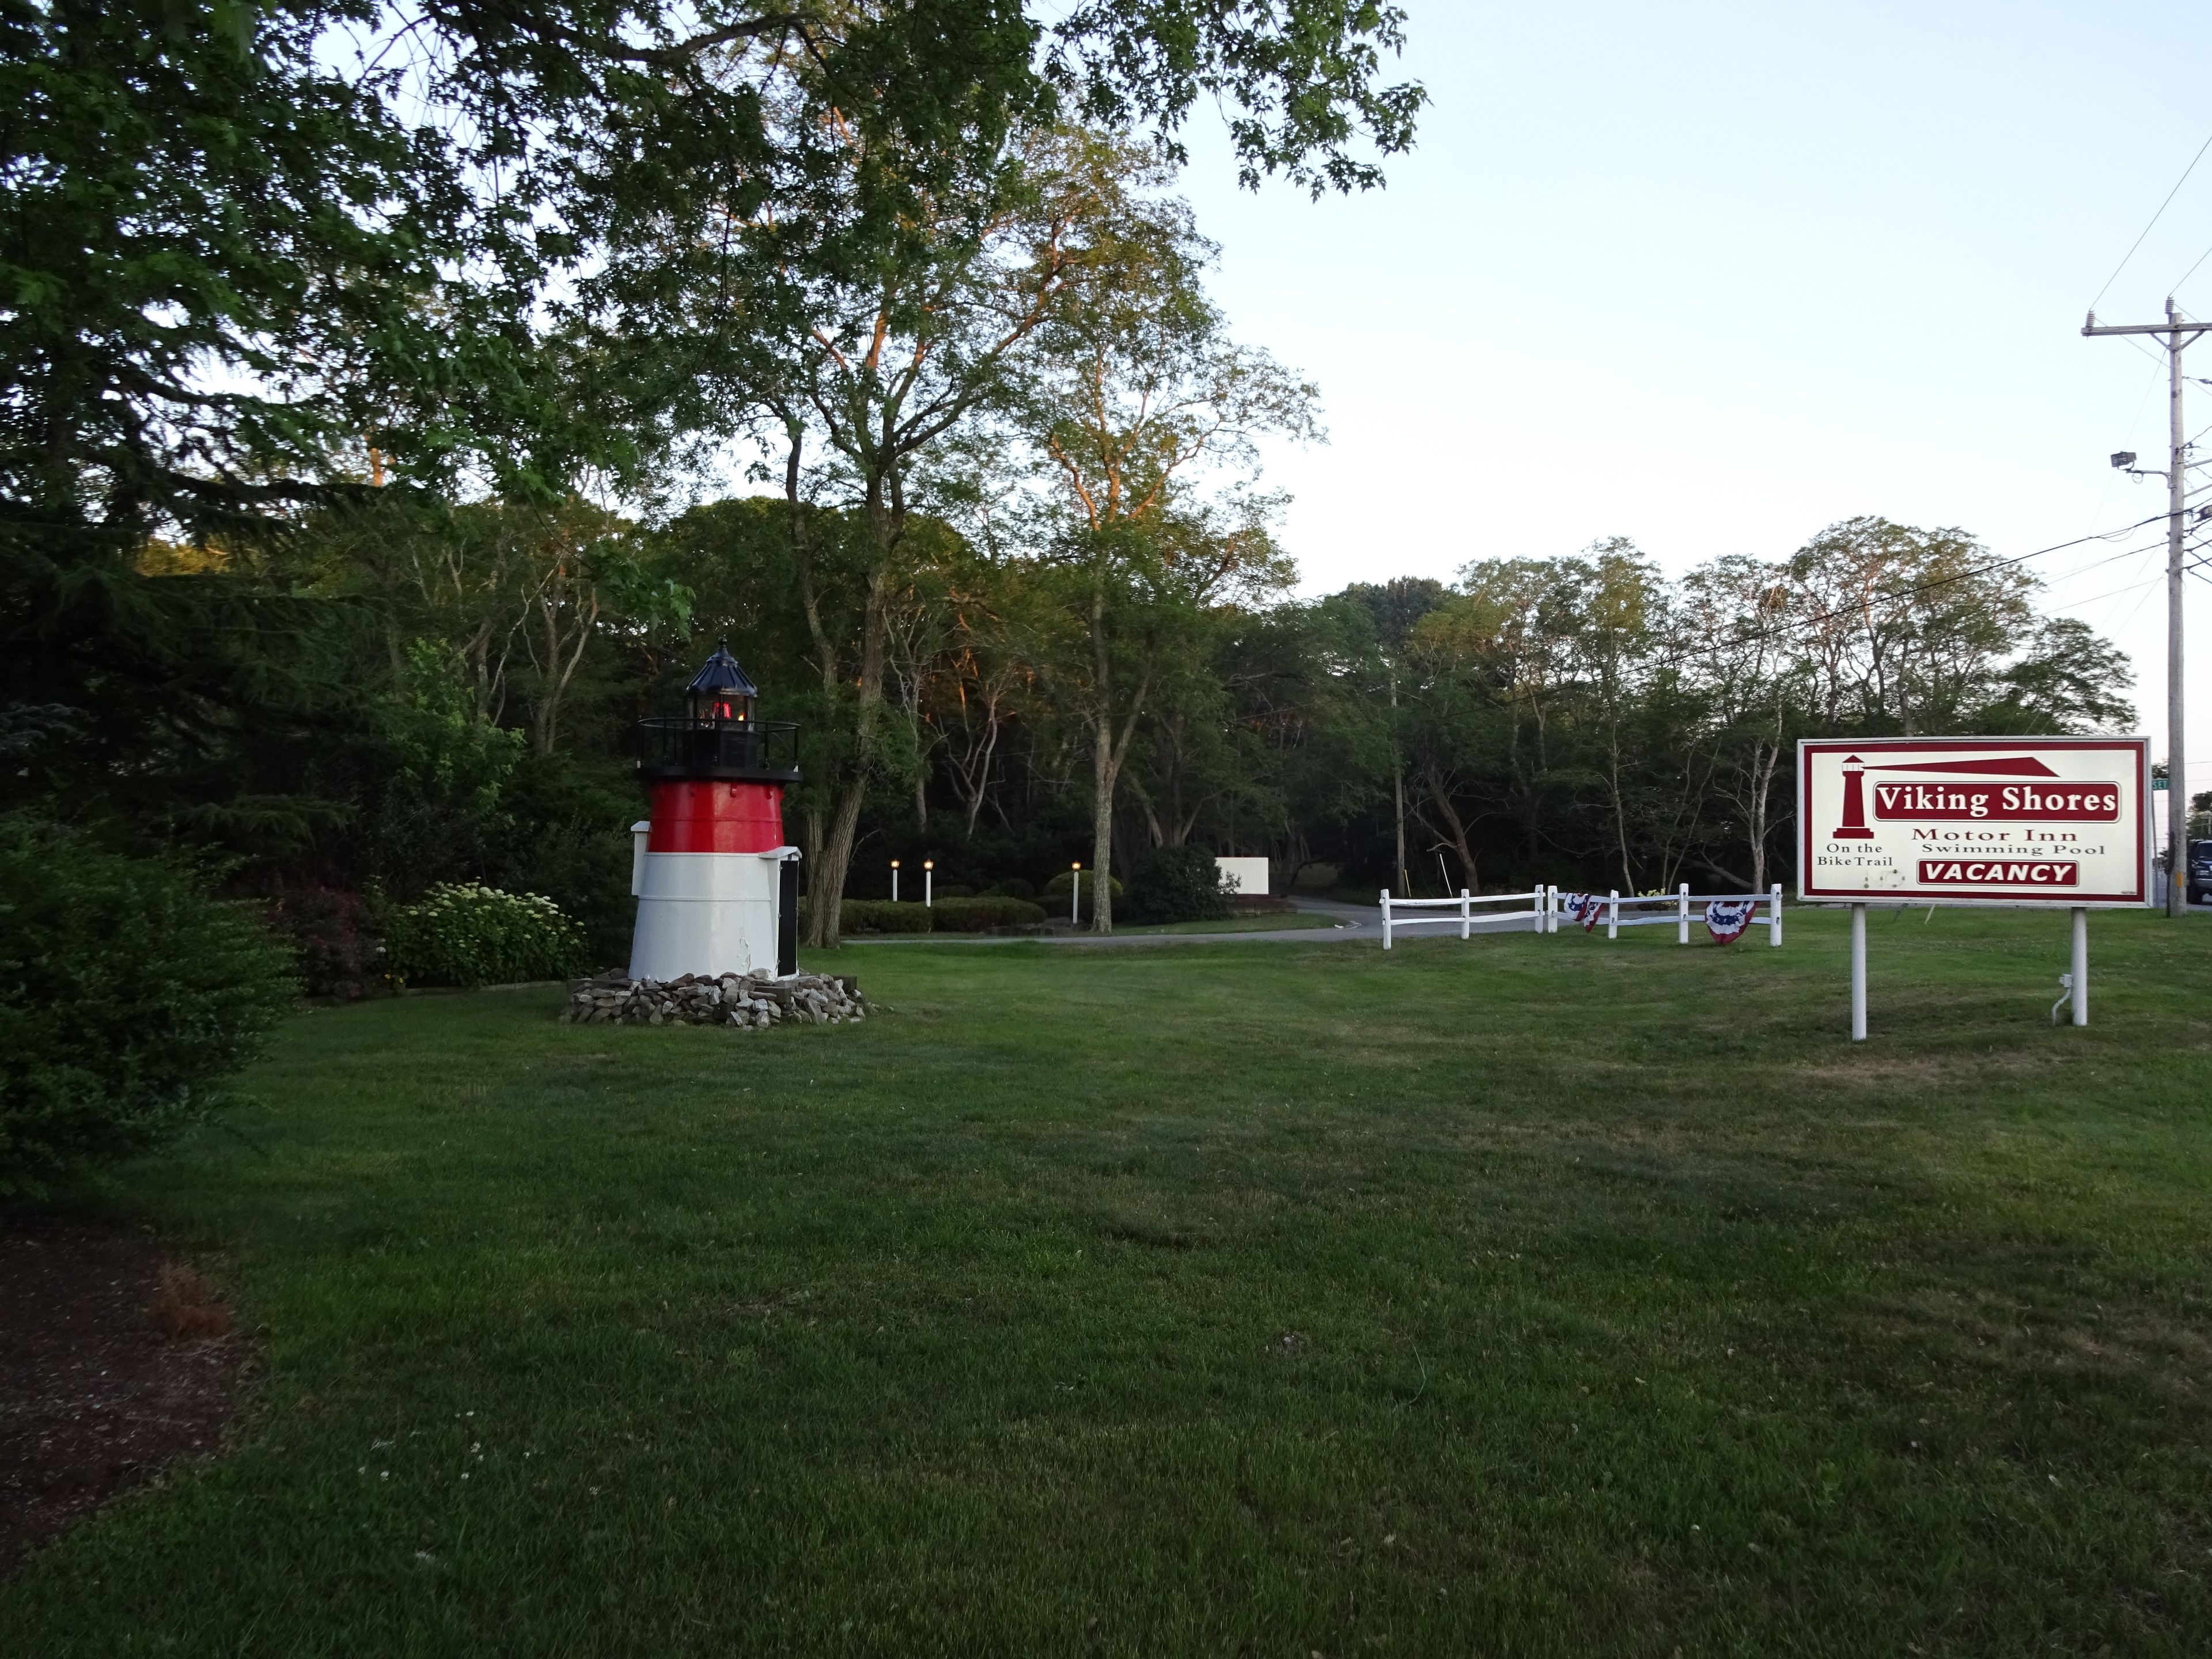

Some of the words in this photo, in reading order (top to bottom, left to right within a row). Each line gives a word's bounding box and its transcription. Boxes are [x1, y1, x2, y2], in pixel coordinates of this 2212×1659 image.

[1877, 786, 1989, 817] Viking
[2002, 786, 2116, 811] Shores
[1911, 828, 2010, 841] Motor
[2024, 829, 2078, 842] Inn
[1827, 843, 1851, 853] On
[1858, 843, 1883, 853] the
[1922, 844, 2043, 856] Swimming
[2053, 845, 2105, 854] Pool
[1817, 856, 1852, 865] Bike
[1854, 857, 1893, 866] Trail
[1926, 863, 2073, 881] VACANCY
